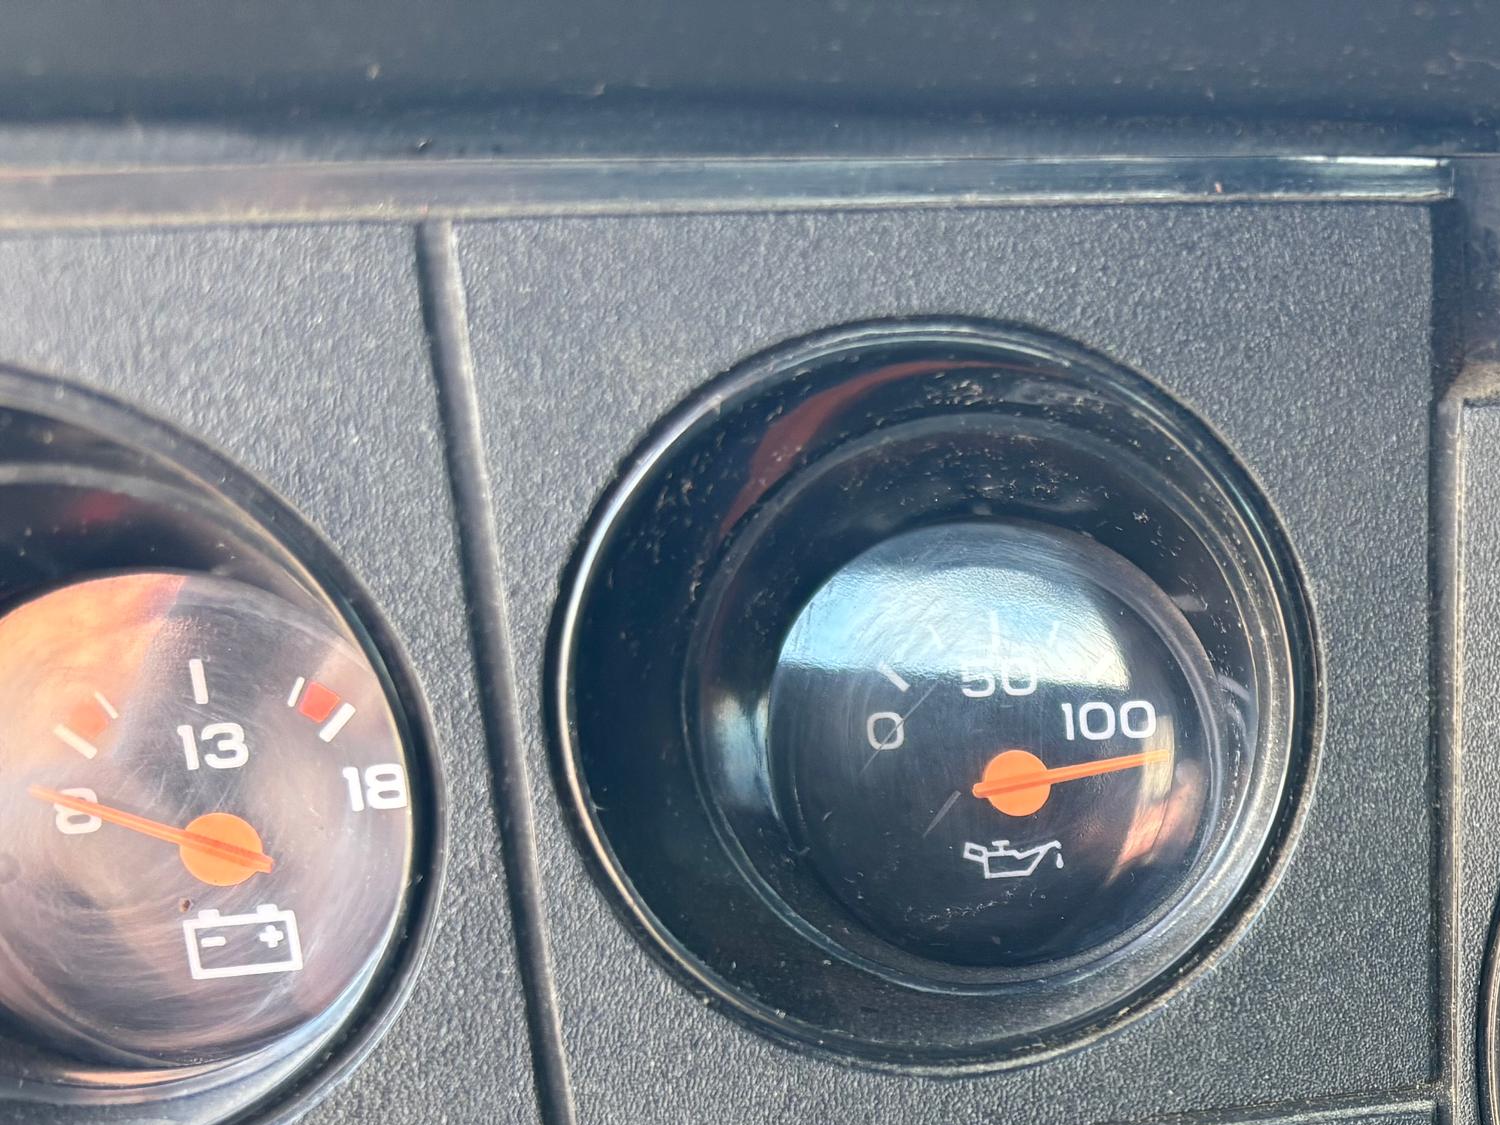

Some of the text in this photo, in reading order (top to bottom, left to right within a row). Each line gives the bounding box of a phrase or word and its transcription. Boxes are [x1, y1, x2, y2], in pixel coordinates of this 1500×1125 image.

[961, 656, 1037, 698] 50
[867, 711, 905, 750] 0
[1061, 700, 1157, 741] 100
[177, 722, 249, 770] 13
[343, 763, 408, 811] 18
[54, 788, 102, 834] 8
